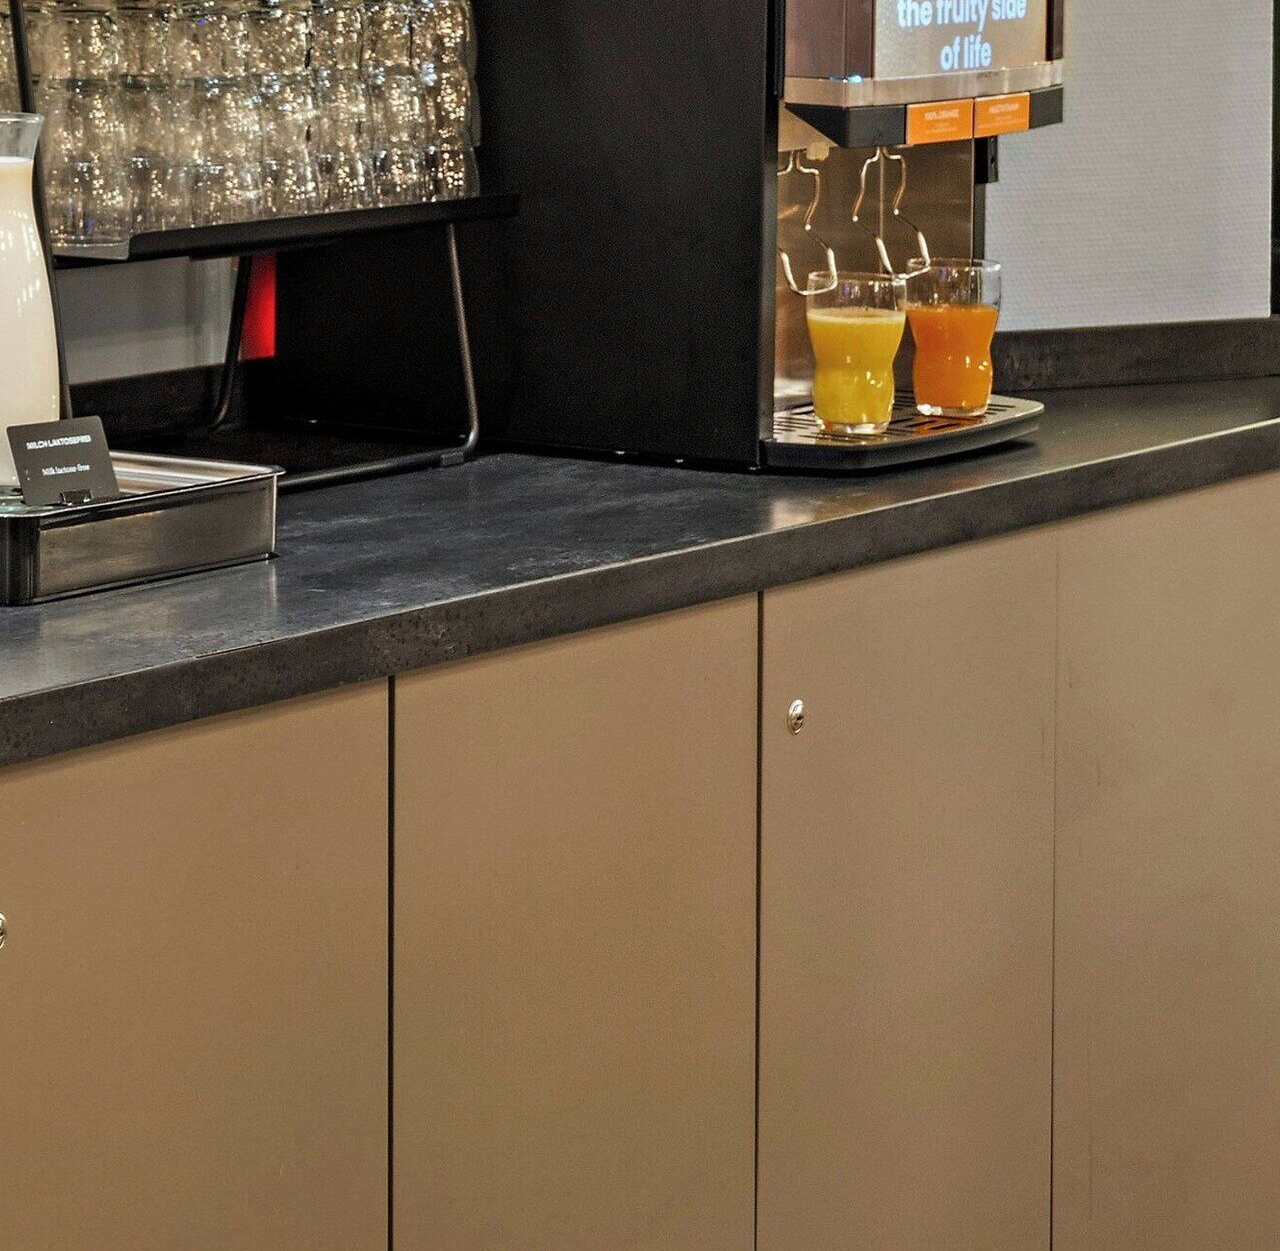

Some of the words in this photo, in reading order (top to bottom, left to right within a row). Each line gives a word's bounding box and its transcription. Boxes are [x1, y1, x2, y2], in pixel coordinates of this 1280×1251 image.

[940, 36, 961, 71] of
[963, 33, 992, 68] life
[26, 440, 48, 450] MILCH
